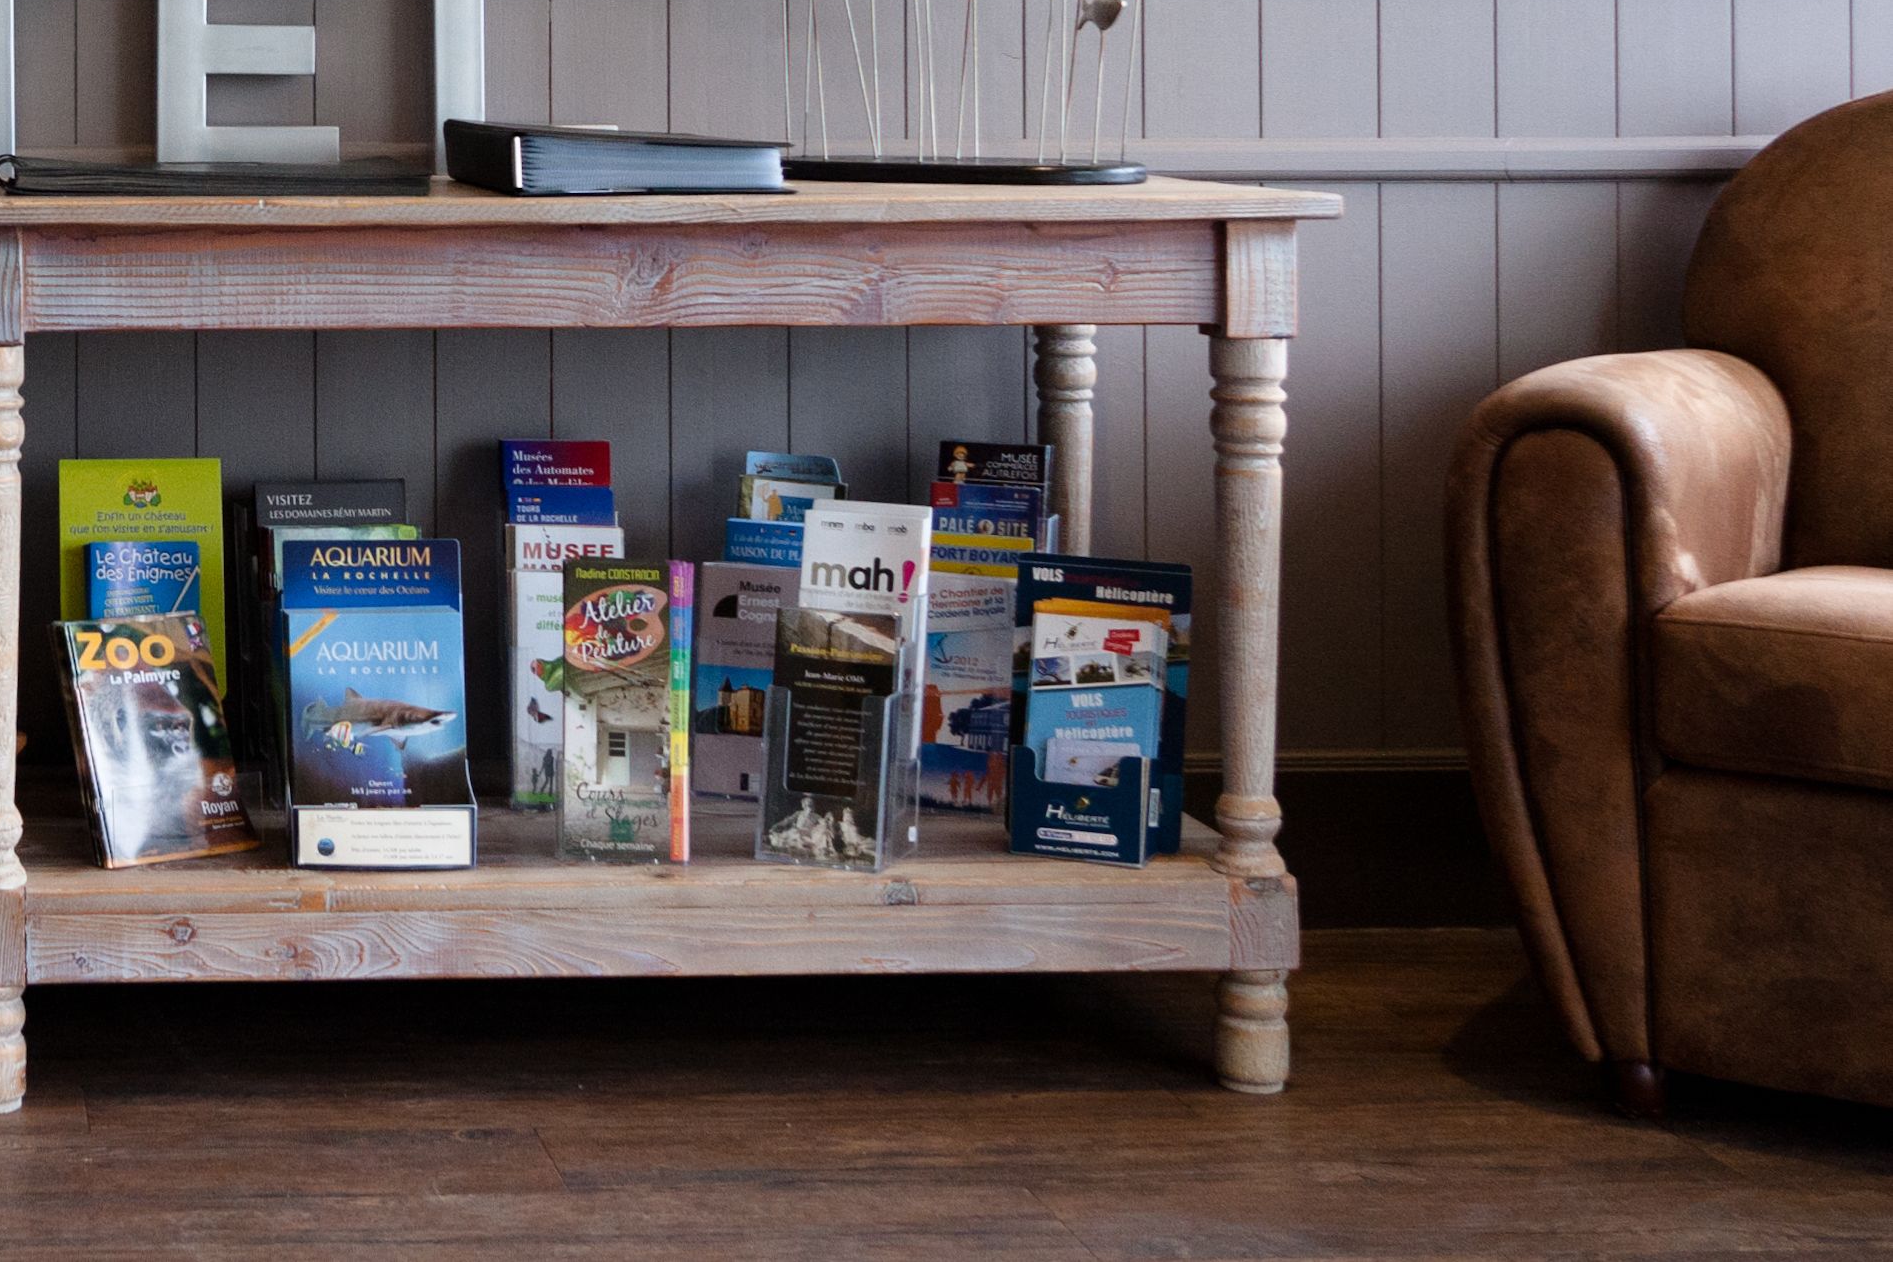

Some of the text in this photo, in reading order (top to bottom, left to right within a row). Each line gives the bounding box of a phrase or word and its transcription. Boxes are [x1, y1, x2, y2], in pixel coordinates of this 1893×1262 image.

[512, 450, 553, 461] Musées
[1001, 452, 1038, 464] MUSÉE
[512, 464, 595, 475] des Automates
[266, 494, 313, 506] VISITEZ
[269, 507, 392, 519] LES DOMAINES RÉMY MARTIN
[517, 505, 540, 513] TOURS
[541, 514, 578, 523] ROCHELLE
[96, 548, 193, 565] Le Château
[310, 546, 431, 567] AQUARIUM
[730, 546, 785, 560] MAISON DU
[930, 546, 1018, 564] FORT BOYAR
[96, 566, 123, 581] des
[312, 571, 431, 580] LA ROCHELLE
[1031, 566, 1065, 583] VOLS
[379, 585, 395, 595] des
[739, 580, 781, 594] Musée
[991, 587, 1004, 596] de
[1095, 586, 1174, 604] Hélicoptère
[579, 591, 655, 629] Atelier
[738, 609, 777, 624] Cogna
[75, 631, 175, 670] ZOO
[316, 640, 439, 662] AQUARIUM
[581, 633, 656, 662] Peinture
[110, 669, 181, 686] La Palmyre
[318, 666, 439, 675] LA ROCHELLE
[1070, 692, 1104, 708] VOLS
[1055, 725, 1134, 739] Hélicoptère
[201, 800, 239, 816] Royan
